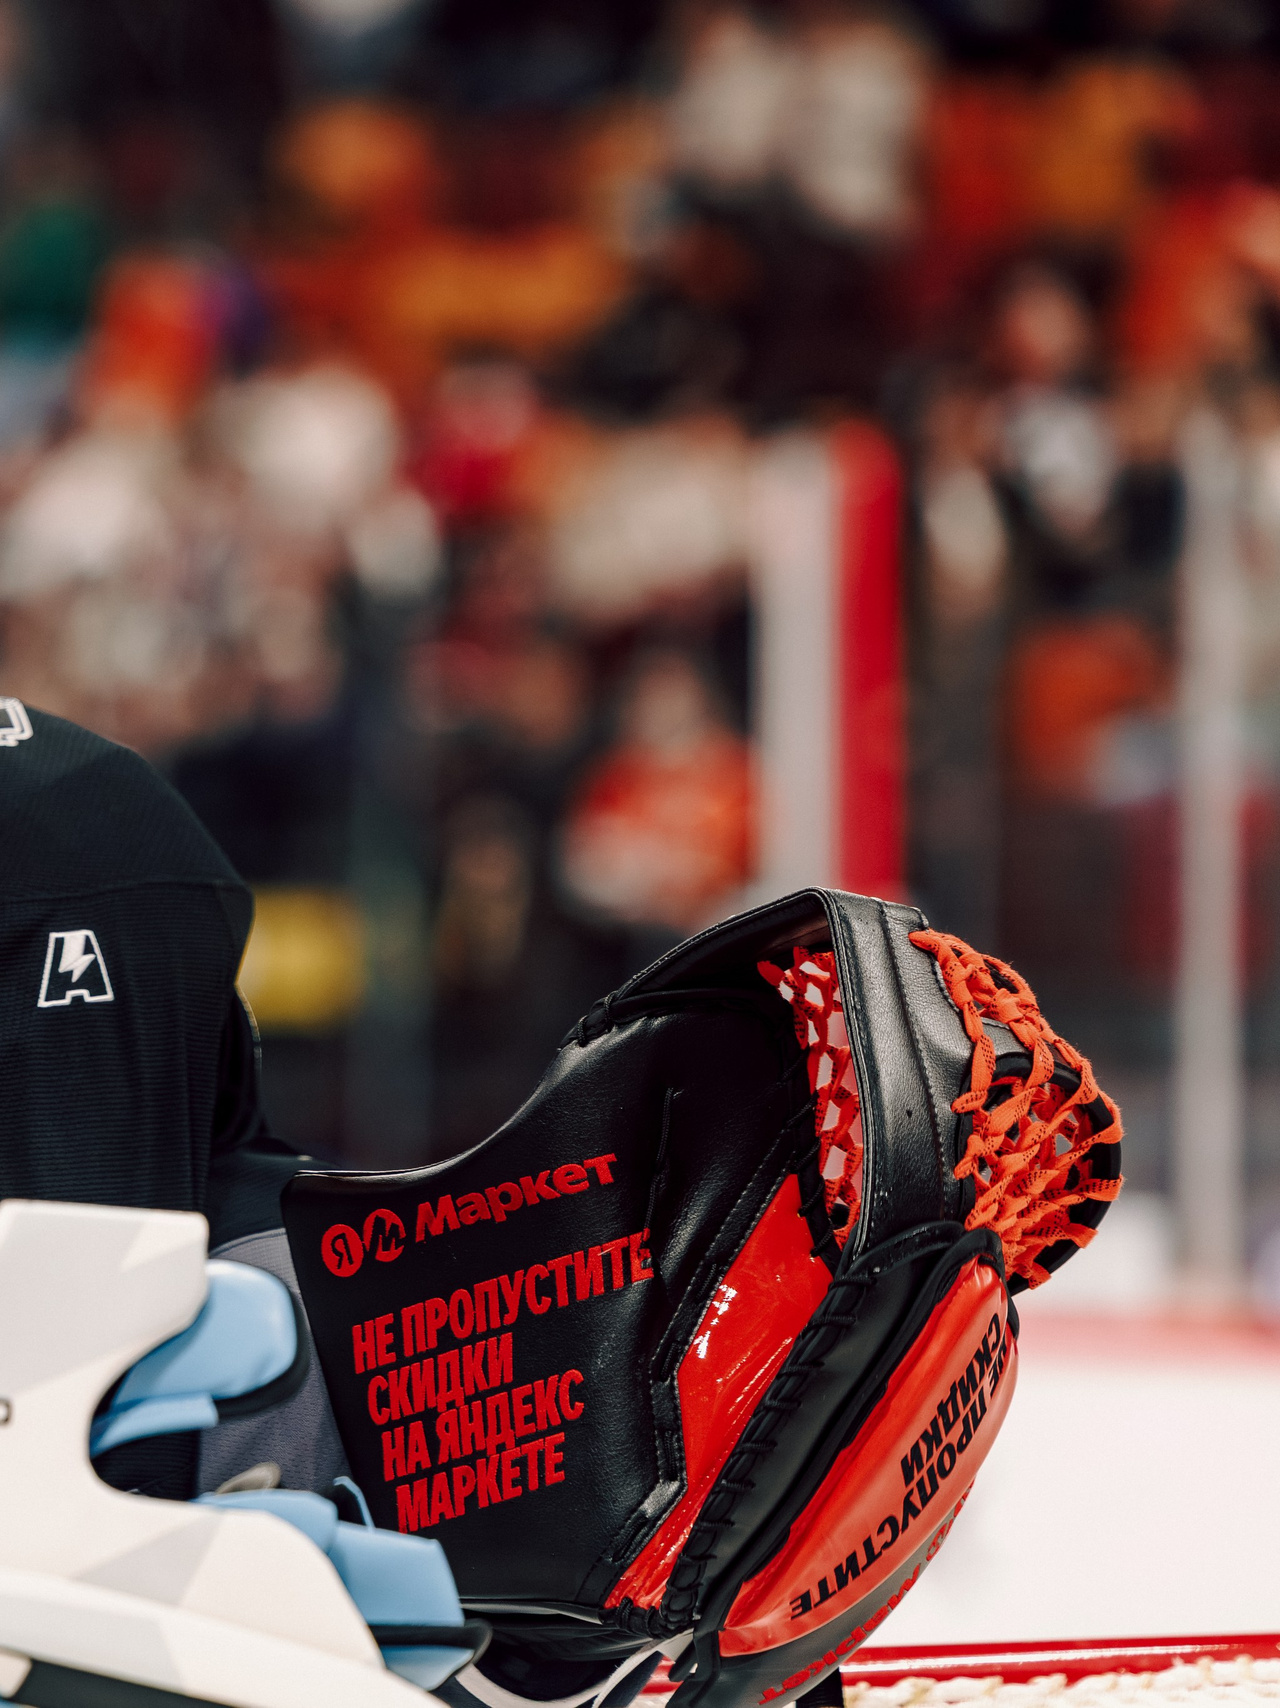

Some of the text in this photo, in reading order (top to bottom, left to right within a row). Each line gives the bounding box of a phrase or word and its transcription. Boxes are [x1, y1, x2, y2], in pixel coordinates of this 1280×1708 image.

[415, 1153, 618, 1243] Маркет
[352, 1228, 654, 1375] НЕ ПРОПУСТИТЕ
[368, 1332, 514, 1426] СКИДКИ
[381, 1369, 584, 1482] НА ЯНДЕКС
[901, 1313, 1000, 1488] СКИДКИ
[396, 1432, 566, 1534] МАРКЕТЕ
[789, 1384, 987, 1620] ПРОПУСТИТЕ
